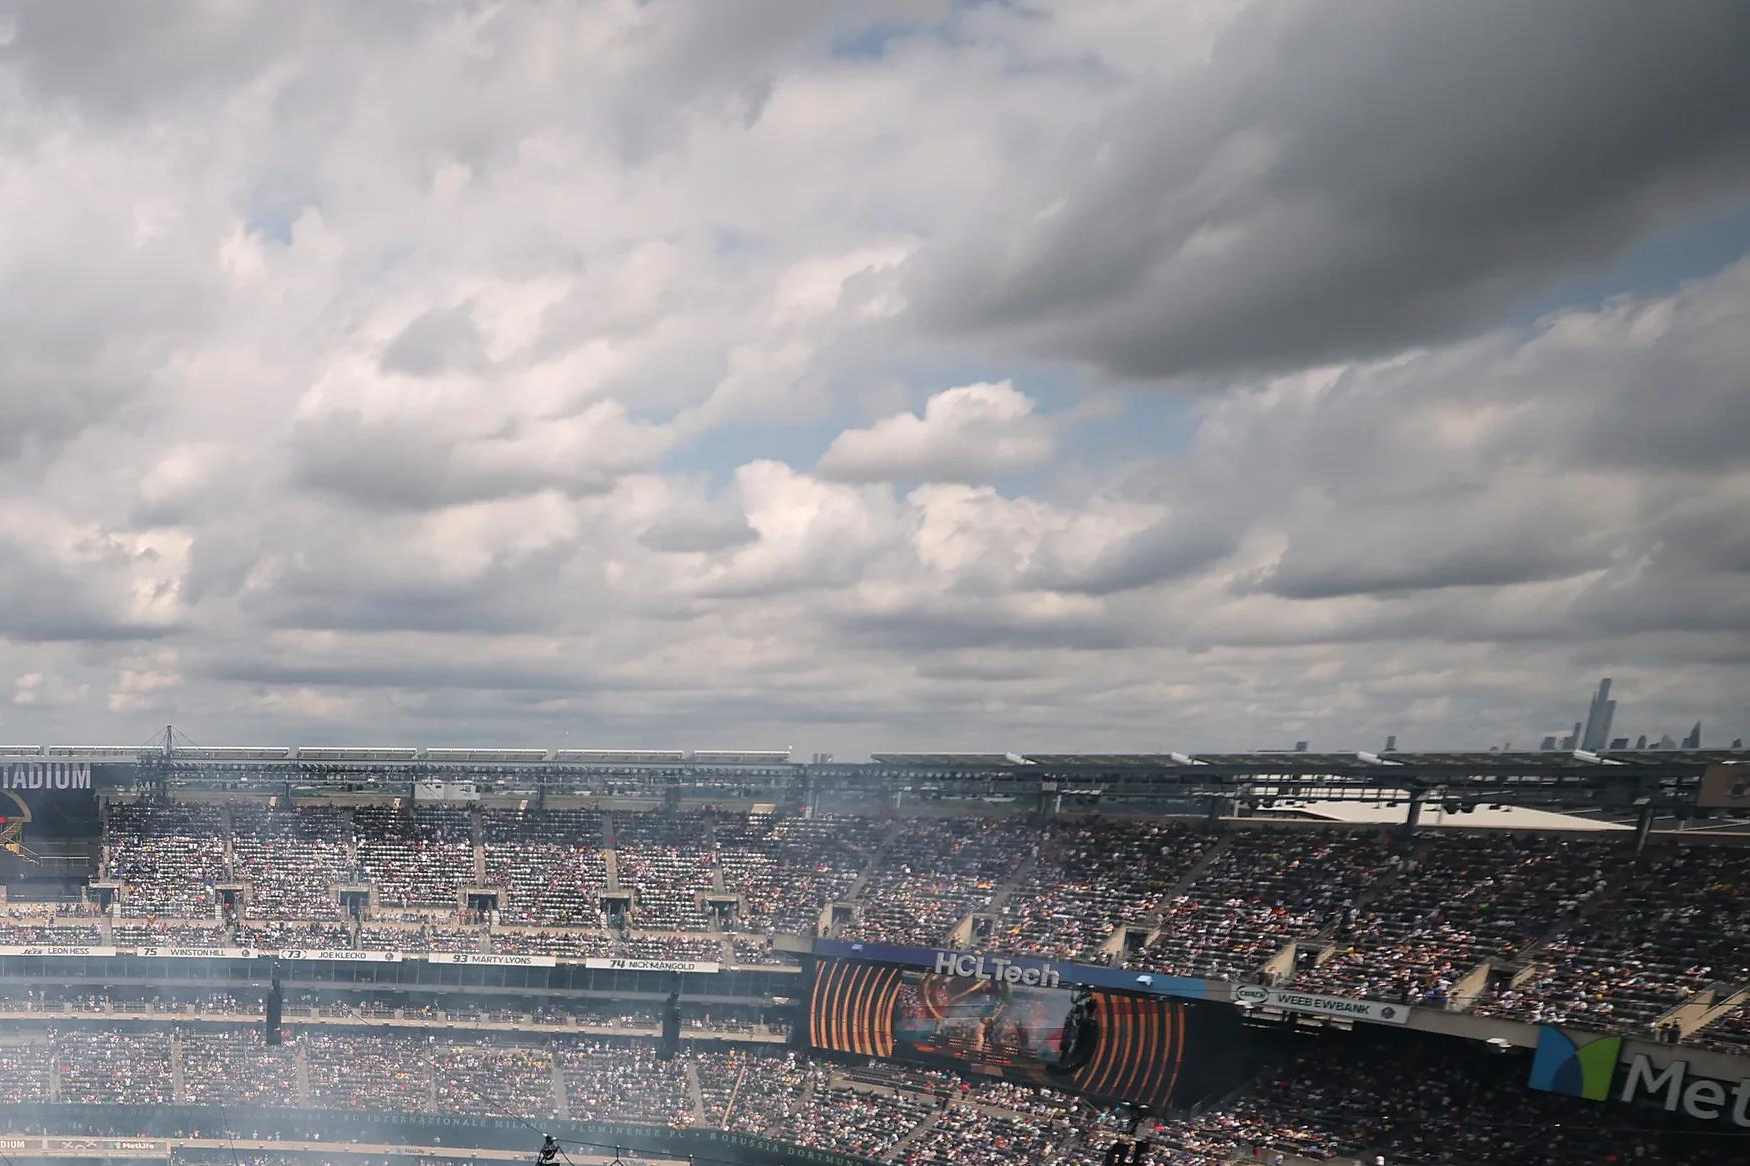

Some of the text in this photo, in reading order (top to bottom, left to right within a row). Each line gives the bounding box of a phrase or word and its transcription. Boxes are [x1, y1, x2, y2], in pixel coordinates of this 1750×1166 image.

[144, 948, 157, 956] 75
[287, 950, 301, 958] 73
[505, 956, 532, 964] LYONS
[609, 960, 626, 968] 74
[650, 961, 694, 970] MANGOLD
[934, 952, 1060, 988] HCLTech
[1278, 994, 1312, 1006] WEEB
[1314, 998, 1370, 1014] EWBANK
[710, 1132, 779, 1152] BORUSSIA
